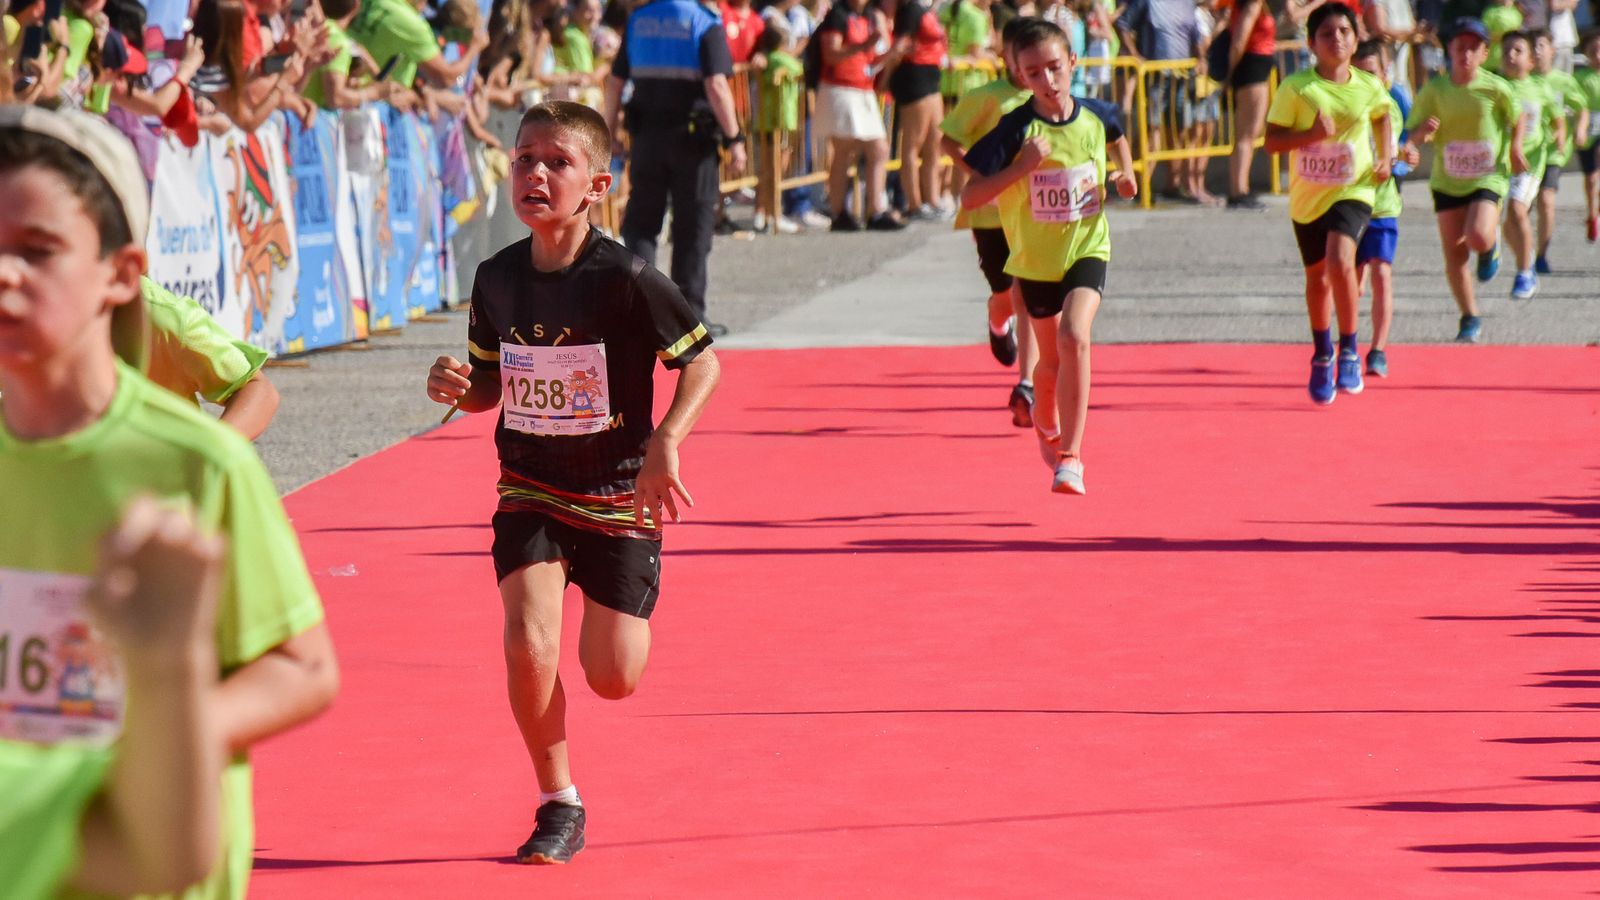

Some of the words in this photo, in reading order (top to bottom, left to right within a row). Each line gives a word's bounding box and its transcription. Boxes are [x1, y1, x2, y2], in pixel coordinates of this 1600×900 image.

[1302, 156, 1337, 173] 1032
[1036, 186, 1079, 208] 1091
[533, 323, 544, 338] S
[503, 350, 516, 366] XXI
[555, 351, 578, 360] JESÚS
[506, 375, 567, 411] 1258
